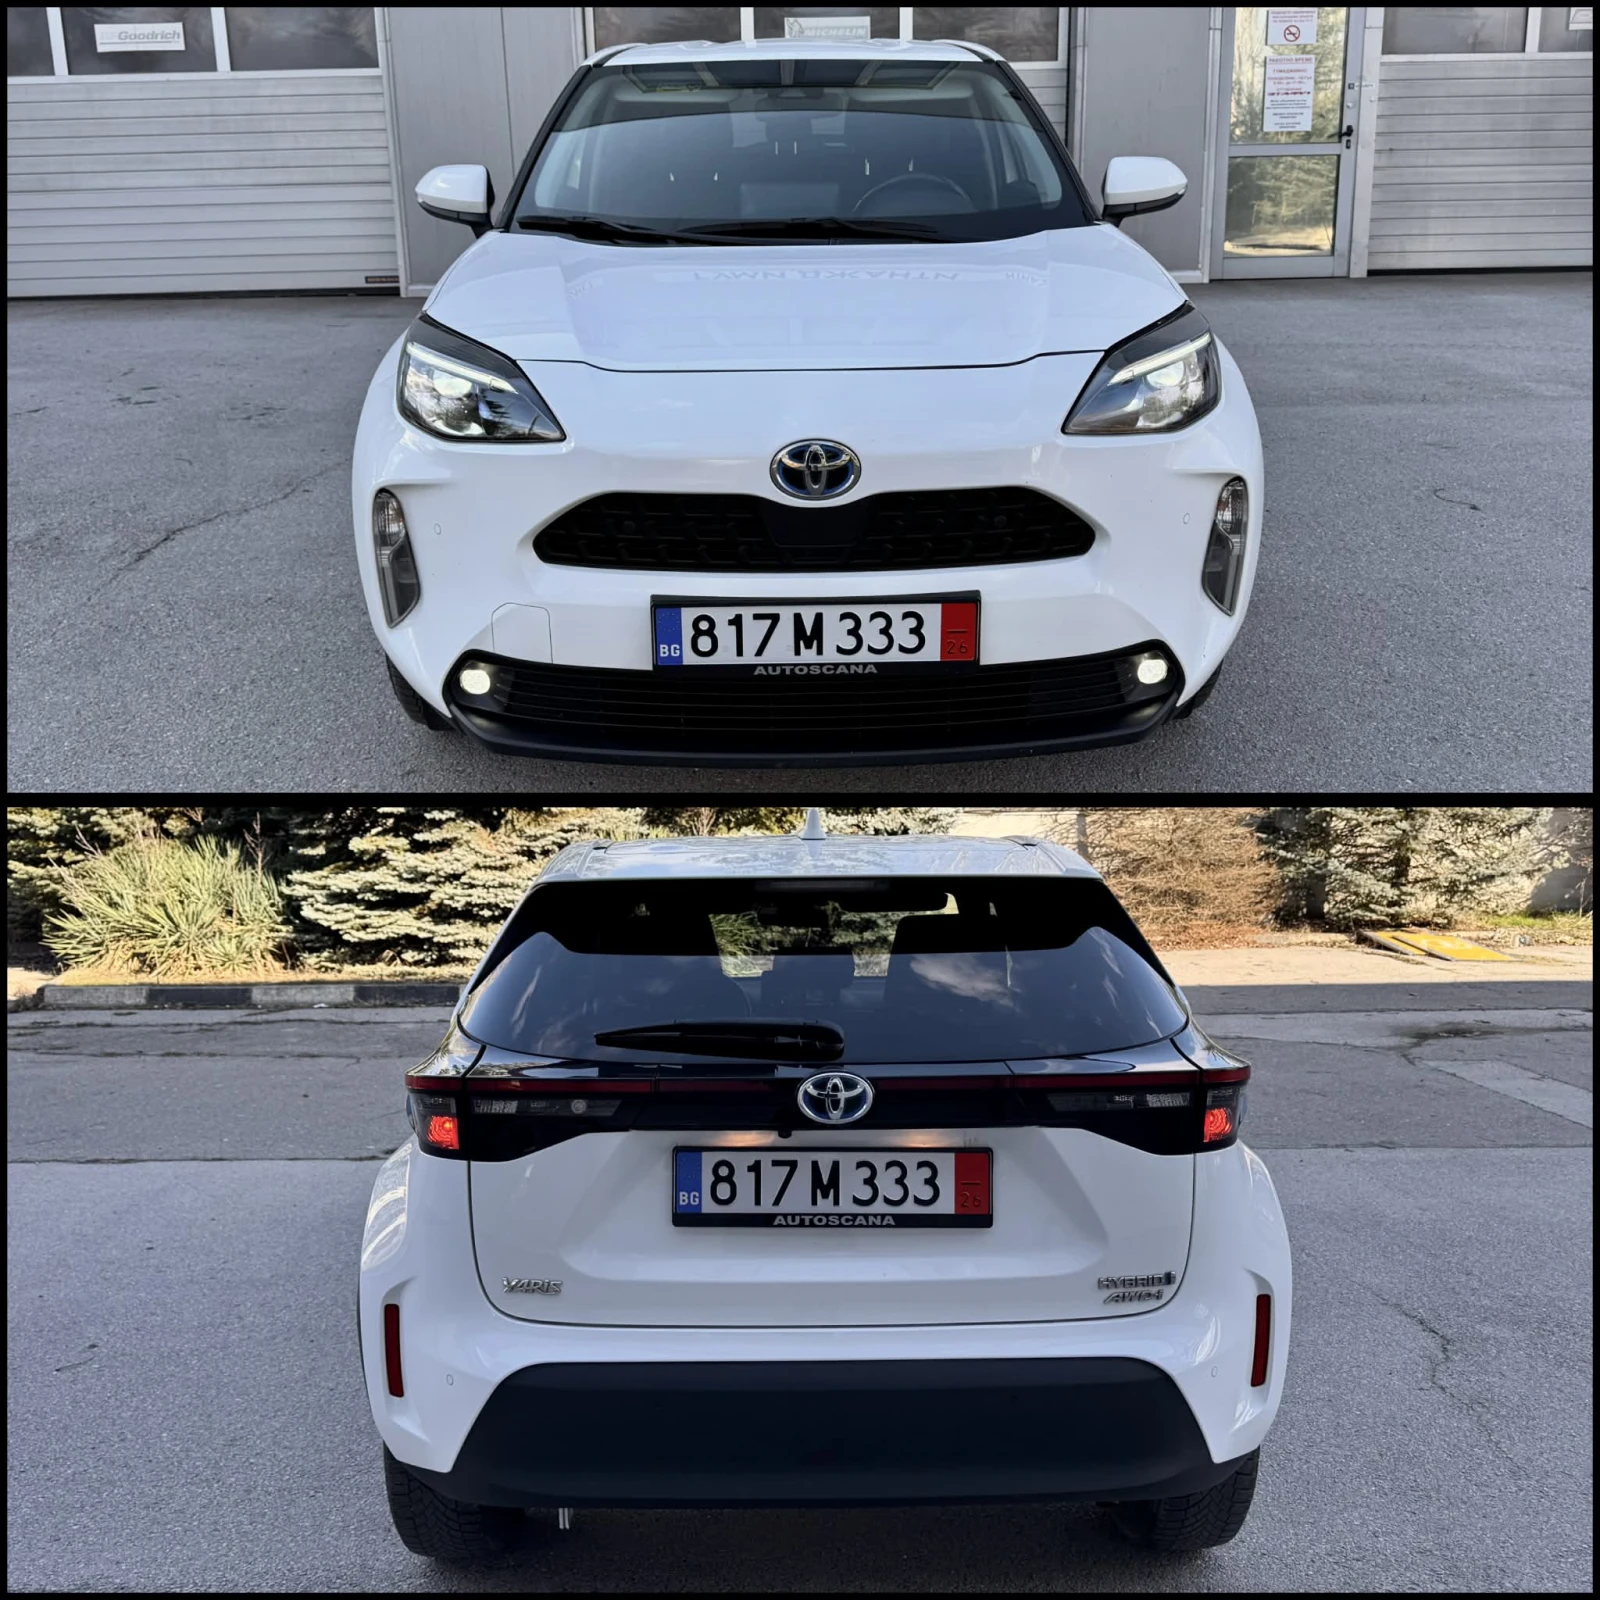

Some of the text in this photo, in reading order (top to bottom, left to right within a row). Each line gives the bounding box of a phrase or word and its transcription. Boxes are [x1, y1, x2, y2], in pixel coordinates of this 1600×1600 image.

[803, 27, 867, 38] MICHELIN
[691, 610, 926, 658] 817 M 333
[659, 644, 681, 657] BG
[946, 639, 969, 655] 26
[753, 664, 879, 676] AUTOSCANA
[710, 1159, 941, 1207] 817 M 333
[679, 1191, 700, 1206] BG
[960, 1191, 982, 1208] 26
[773, 1214, 896, 1226] AUTOSCANA
[1098, 1275, 1165, 1290] HYBRID
